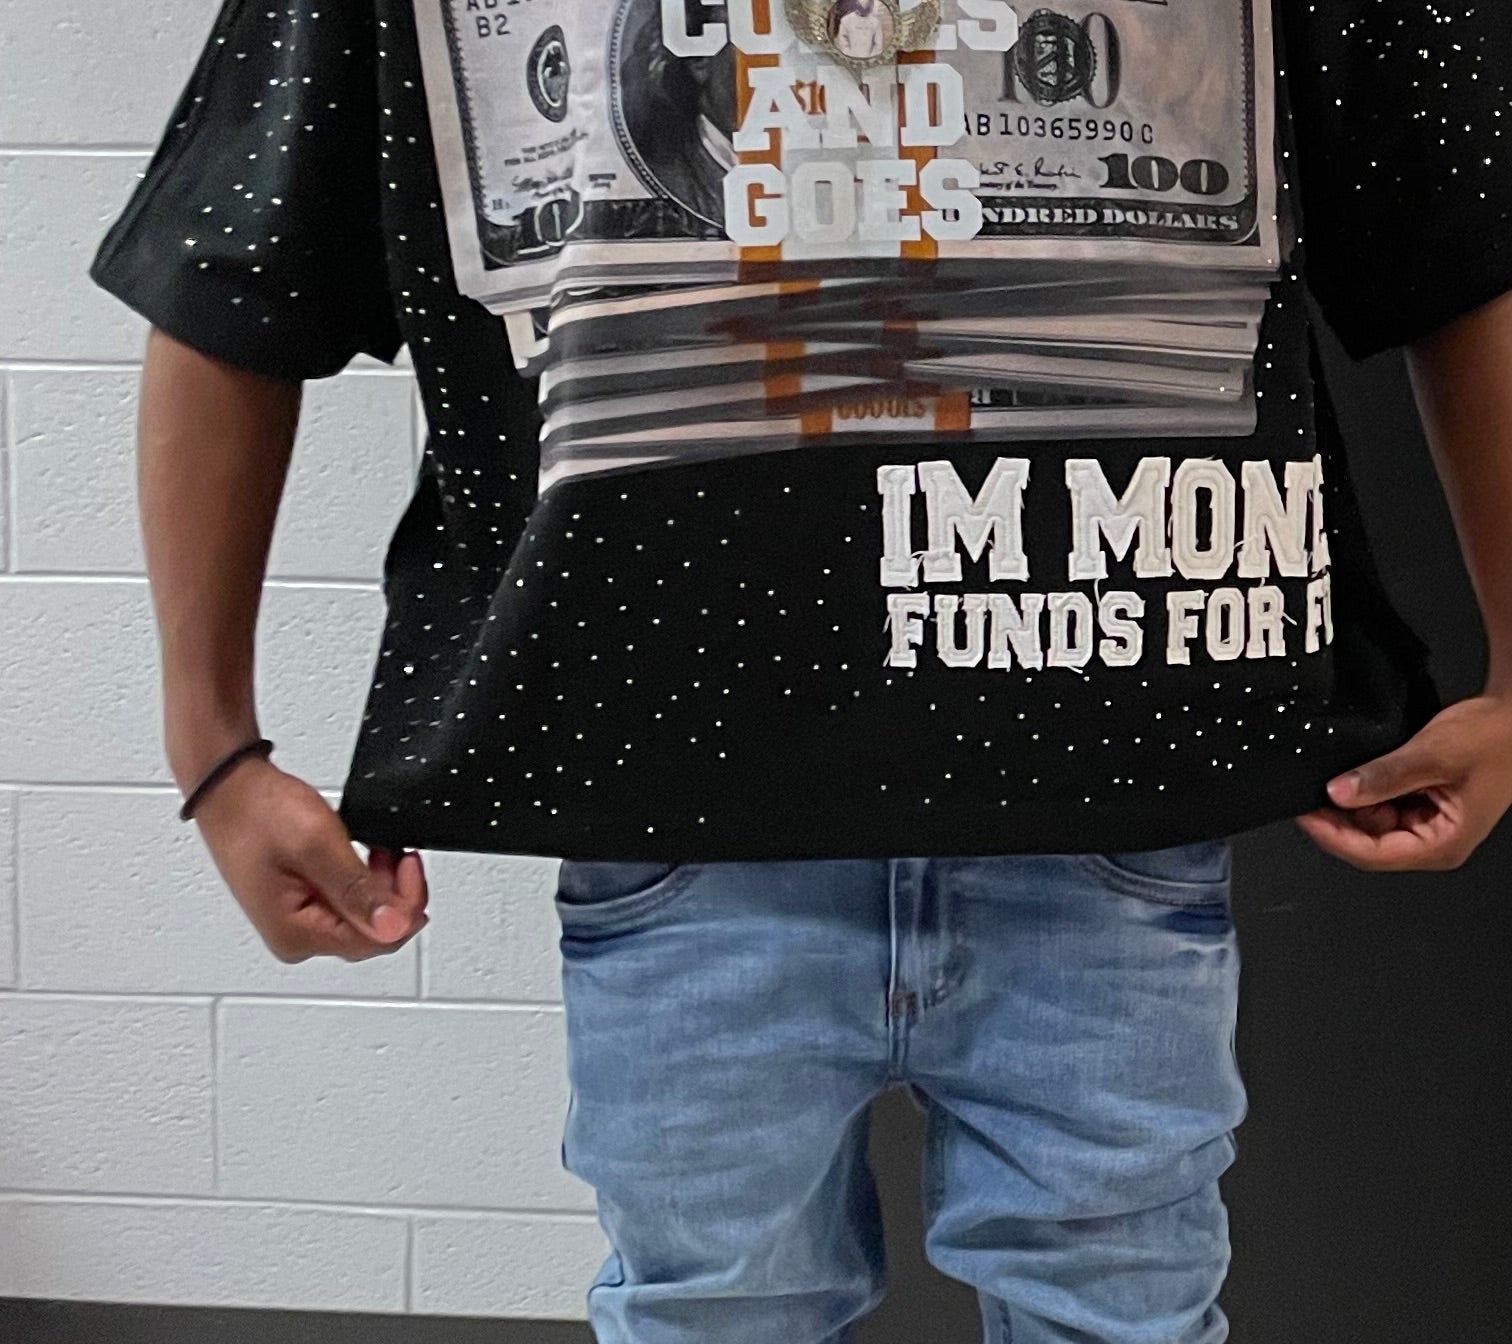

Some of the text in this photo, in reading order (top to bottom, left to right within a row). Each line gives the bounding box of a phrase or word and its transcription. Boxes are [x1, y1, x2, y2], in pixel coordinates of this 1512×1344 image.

[476, 13, 511, 38] B2
[733, 64, 965, 151] AND
[723, 159, 984, 246] GOES
[1097, 153, 1230, 196] 100
[1102, 208, 1239, 231] DOLLARS
[877, 457, 1031, 588] IM
[886, 590, 1146, 671] FUNDS
[1165, 585, 1287, 665] FOR
